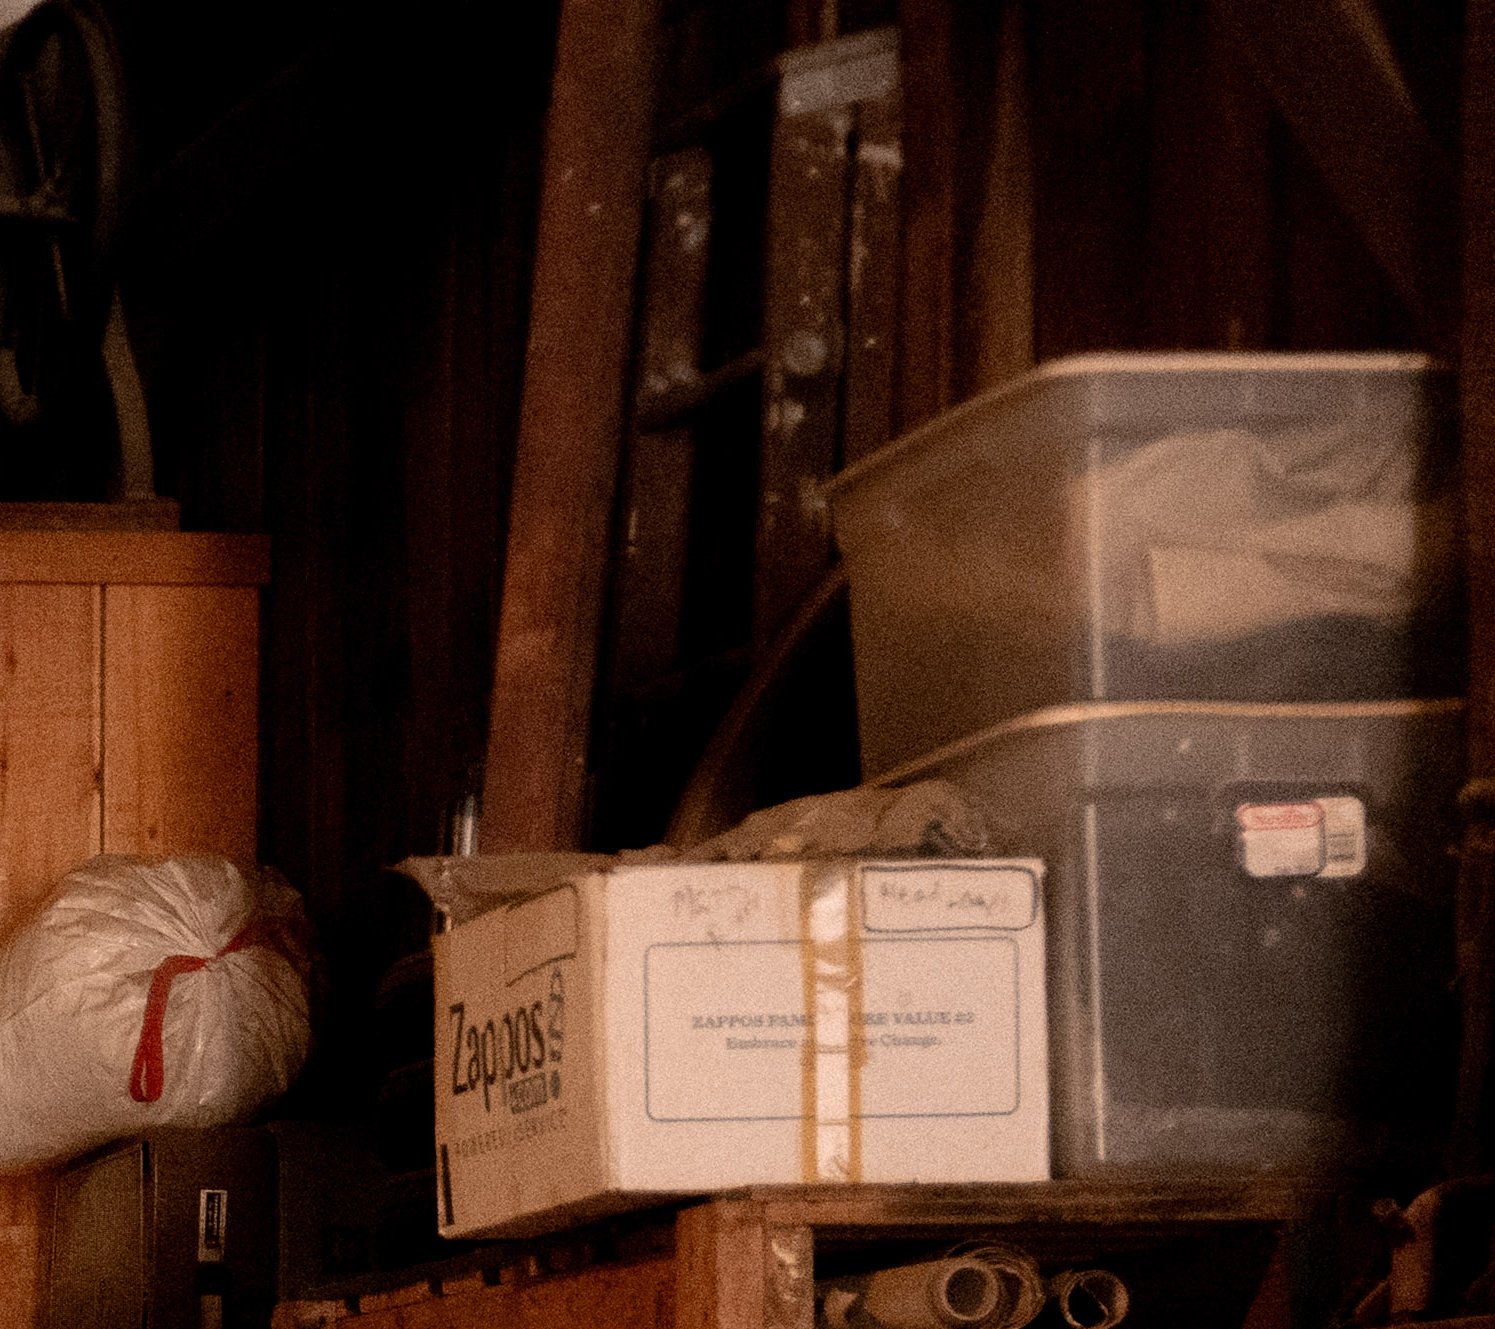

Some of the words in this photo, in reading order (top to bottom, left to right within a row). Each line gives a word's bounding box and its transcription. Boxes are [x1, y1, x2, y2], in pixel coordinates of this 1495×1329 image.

[692, 1014, 763, 1029] ZAPPOS
[768, 1014, 812, 1028] FAM
[892, 1011, 951, 1025] VALUE
[450, 1001, 546, 1112] Zappos
